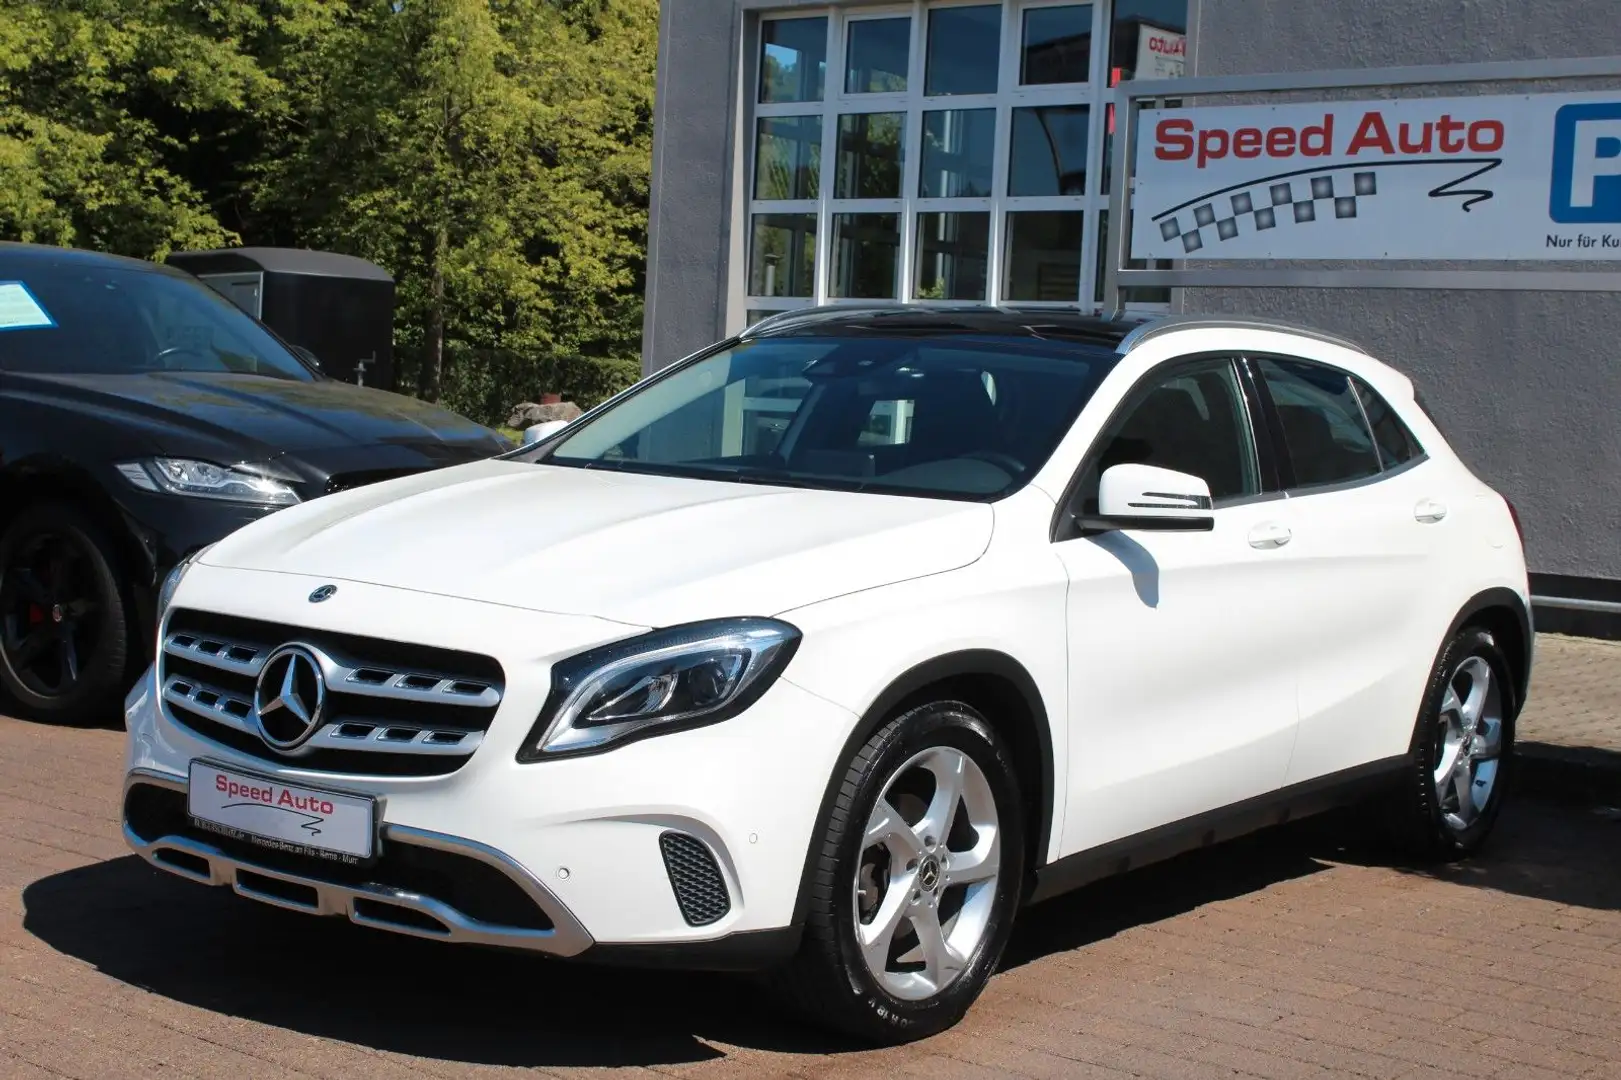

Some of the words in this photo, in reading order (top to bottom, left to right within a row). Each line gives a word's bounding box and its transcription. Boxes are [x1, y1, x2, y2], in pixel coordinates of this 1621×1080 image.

[1154, 113, 1335, 168] Speed
[1345, 111, 1505, 156] Auto
[1546, 234, 1573, 248] Nur
[1577, 233, 1598, 248] für
[1602, 234, 1621, 248] Ku
[215, 774, 273, 804] Speed
[277, 789, 334, 815] Auto
